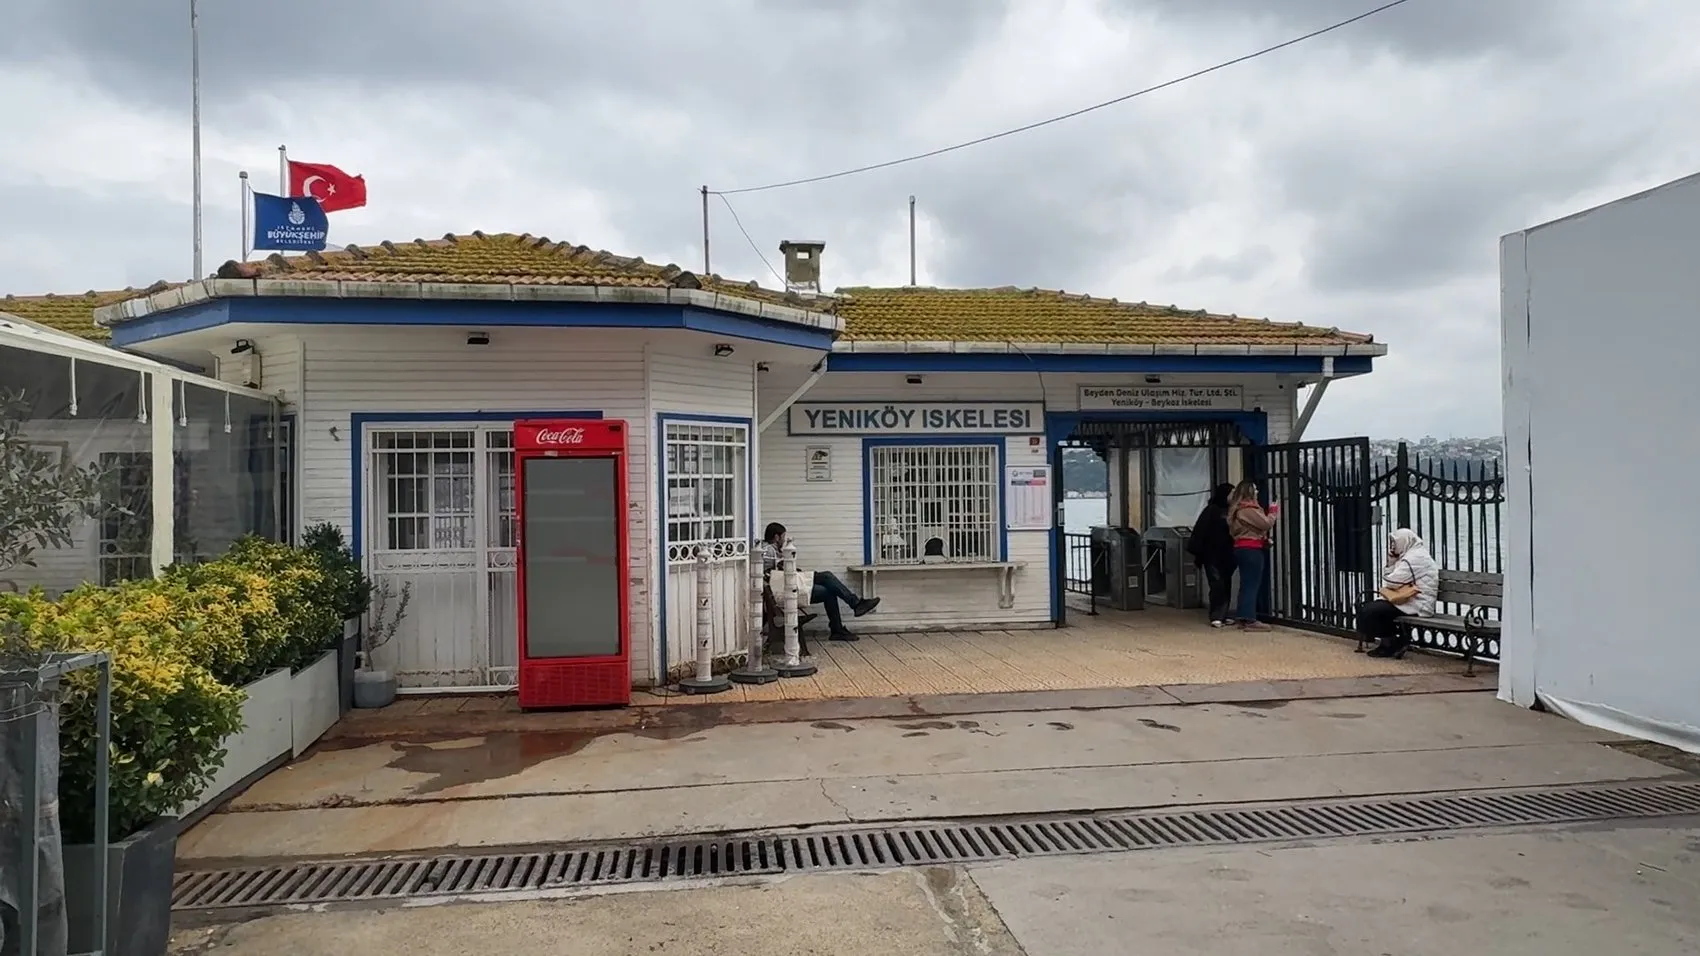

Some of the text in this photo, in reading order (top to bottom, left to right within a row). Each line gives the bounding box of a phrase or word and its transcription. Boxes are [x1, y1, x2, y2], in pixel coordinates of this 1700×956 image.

[1116, 388, 1139, 397] Deniz
[804, 405, 1031, 429] YENIKÖY ISKELESI
[536, 427, 585, 444] Coca-Cola
